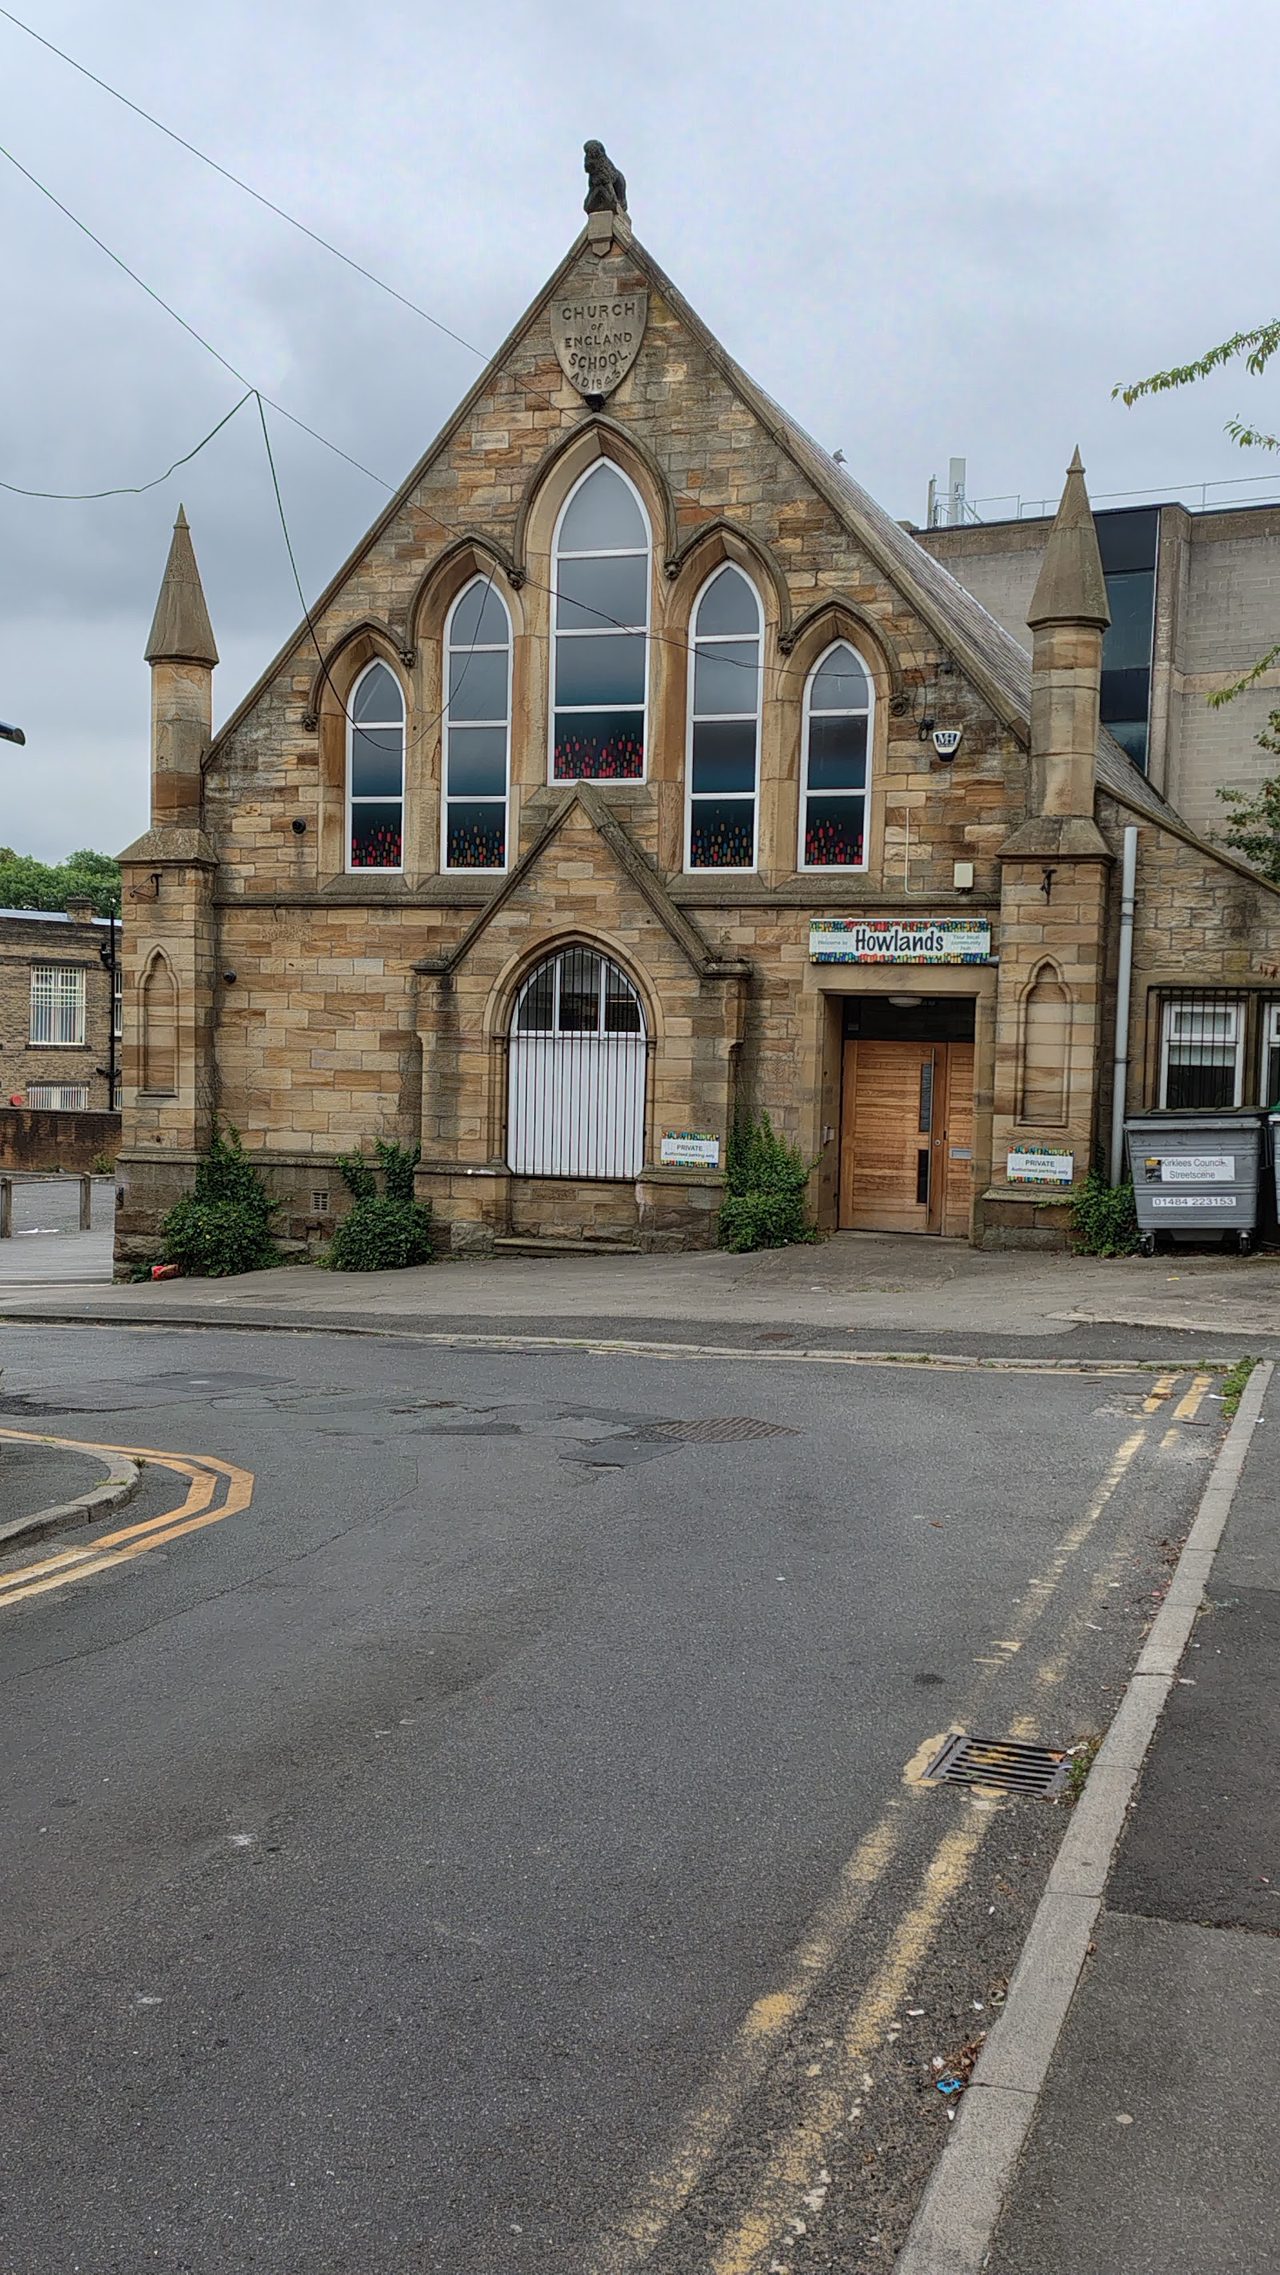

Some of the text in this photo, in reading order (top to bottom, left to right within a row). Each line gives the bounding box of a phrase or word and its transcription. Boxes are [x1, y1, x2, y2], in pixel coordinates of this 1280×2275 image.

[562, 302, 635, 320] CHURCH
[565, 332, 632, 348] ENGLAND
[855, 929, 944, 951] Howlands
[1162, 1159, 1223, 1167] Kirklees Council
[1169, 1170, 1216, 1179] Streetscene
